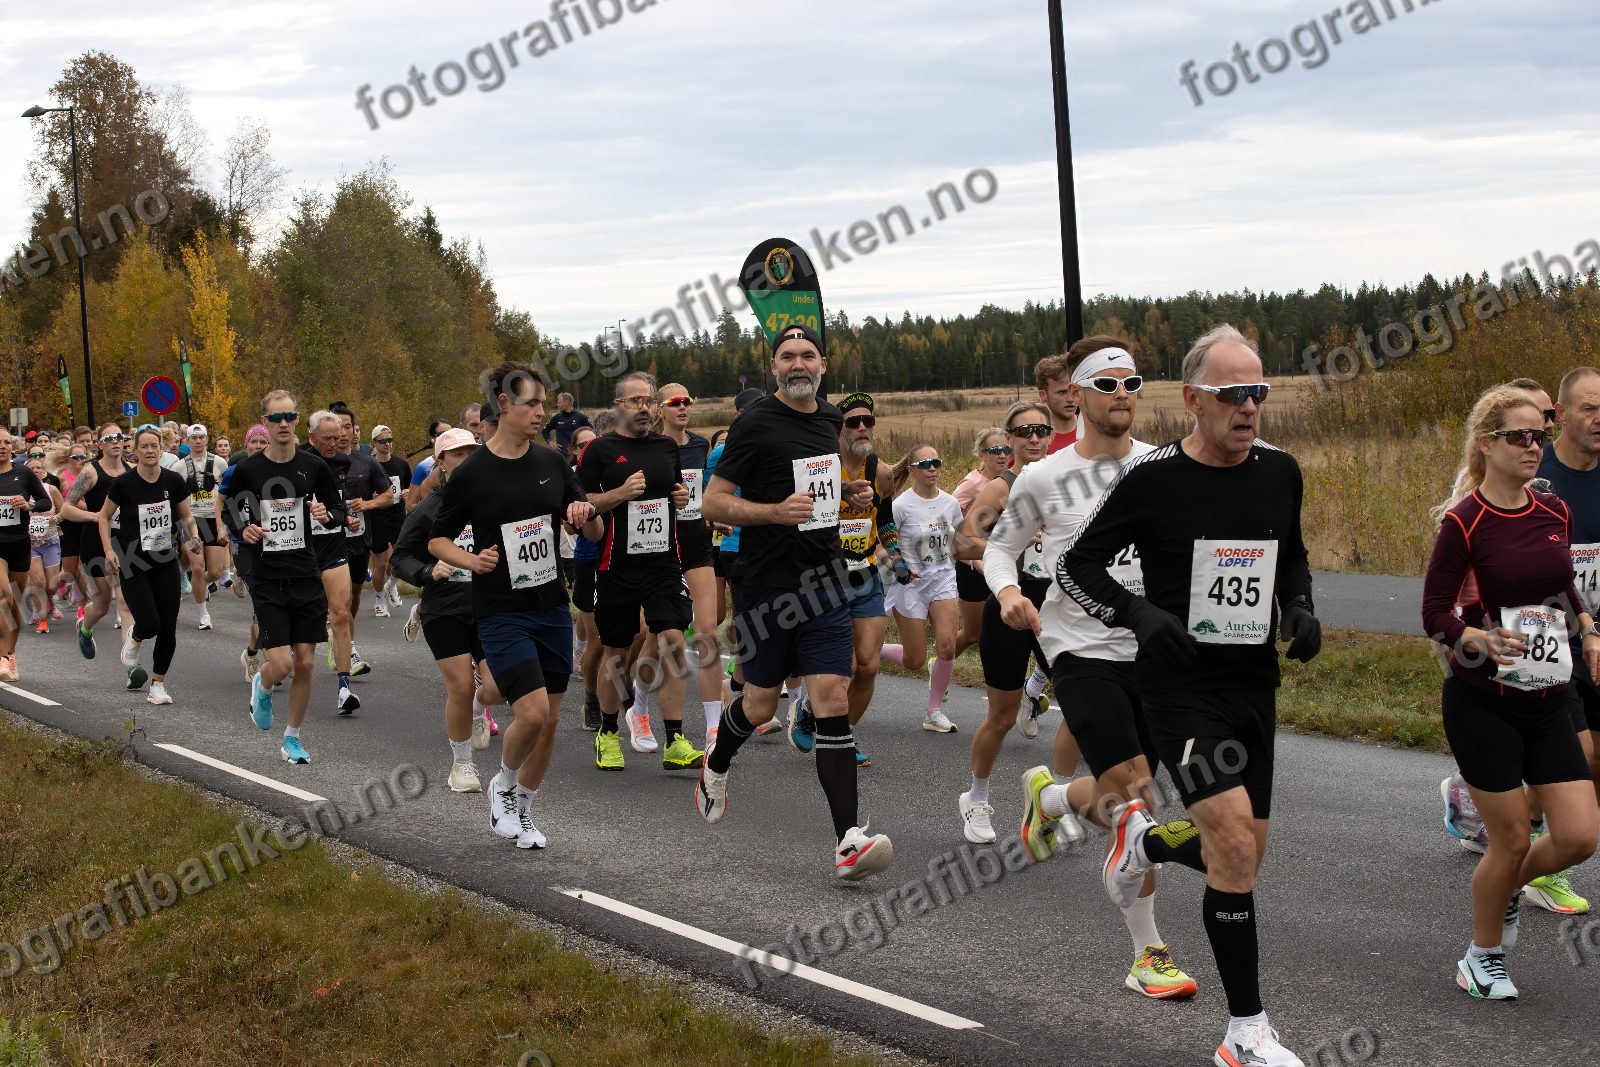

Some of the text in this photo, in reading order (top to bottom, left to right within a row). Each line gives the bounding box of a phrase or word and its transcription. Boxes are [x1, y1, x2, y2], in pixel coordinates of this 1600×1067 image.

[792, 294, 815, 303] Under
[807, 479, 834, 502] 441
[143, 515, 169, 529] 1012
[270, 516, 296, 532] 565
[515, 520, 544, 533] NORGES
[637, 518, 662, 534] 473
[519, 528, 541, 538] LØPET
[929, 534, 948, 549] 810
[518, 539, 547, 563] 400
[1214, 548, 1264, 558] NORGES
[1218, 558, 1256, 568] LØPET
[1208, 576, 1260, 607] 435
[1518, 609, 1556, 622] NORGES
[1224, 621, 1268, 633] Aurskog
[1522, 618, 1551, 628] LØPET
[1522, 633, 1559, 663] 482
